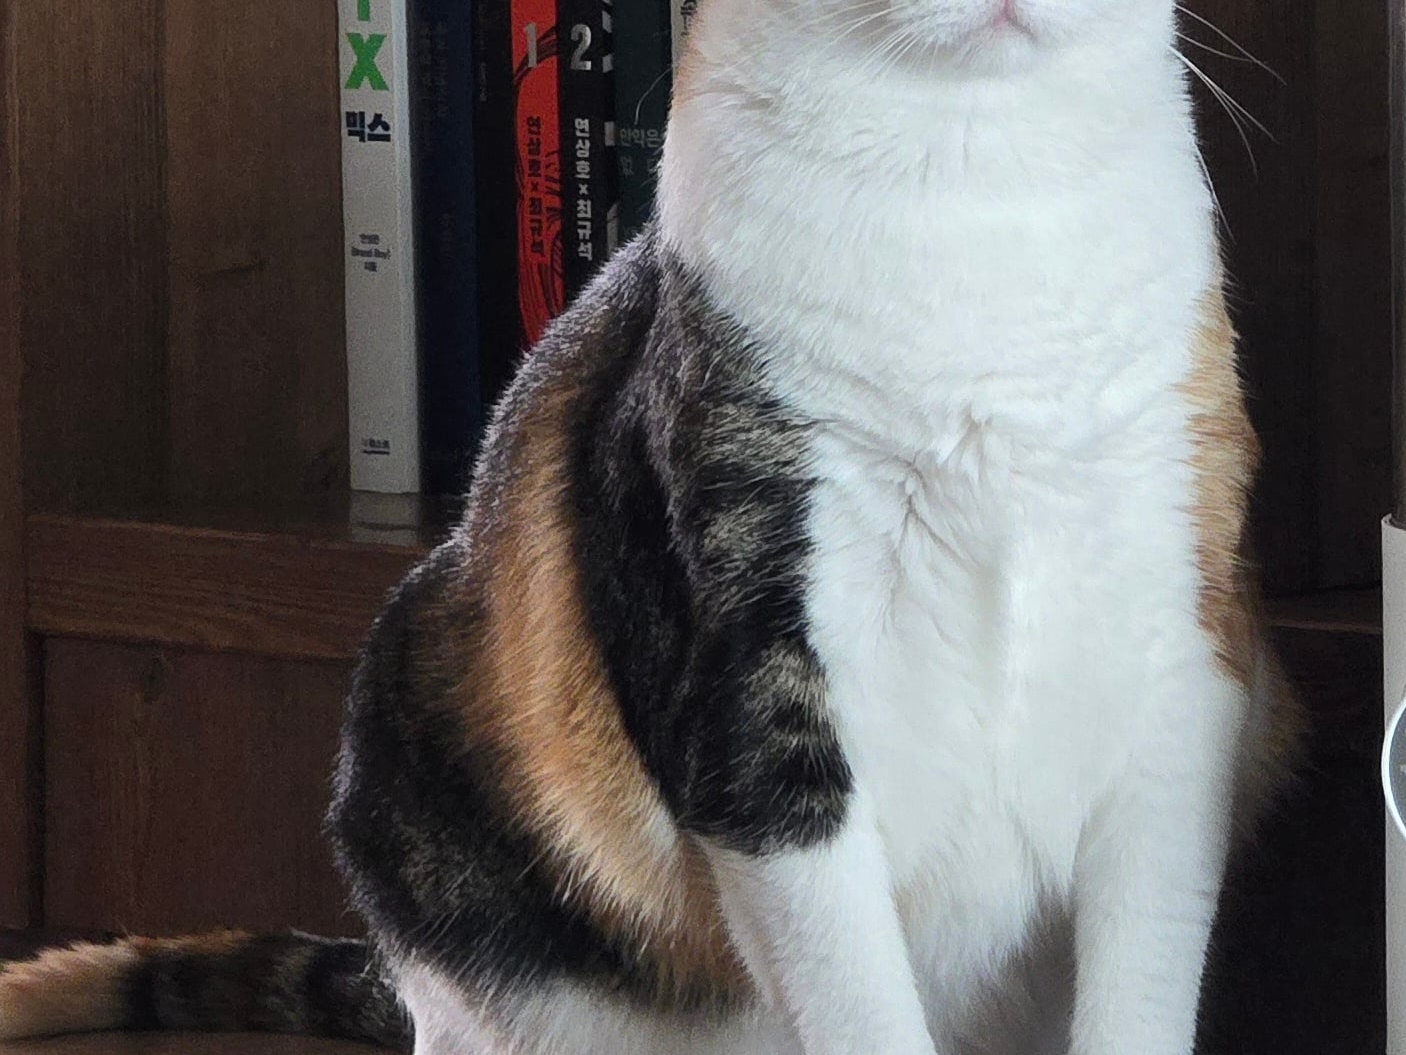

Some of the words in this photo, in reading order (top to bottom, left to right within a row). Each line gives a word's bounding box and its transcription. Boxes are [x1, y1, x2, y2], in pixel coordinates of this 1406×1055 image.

[523, 22, 540, 70] 1
[569, 24, 593, 72] 2
[344, 111, 392, 143] 믹스
